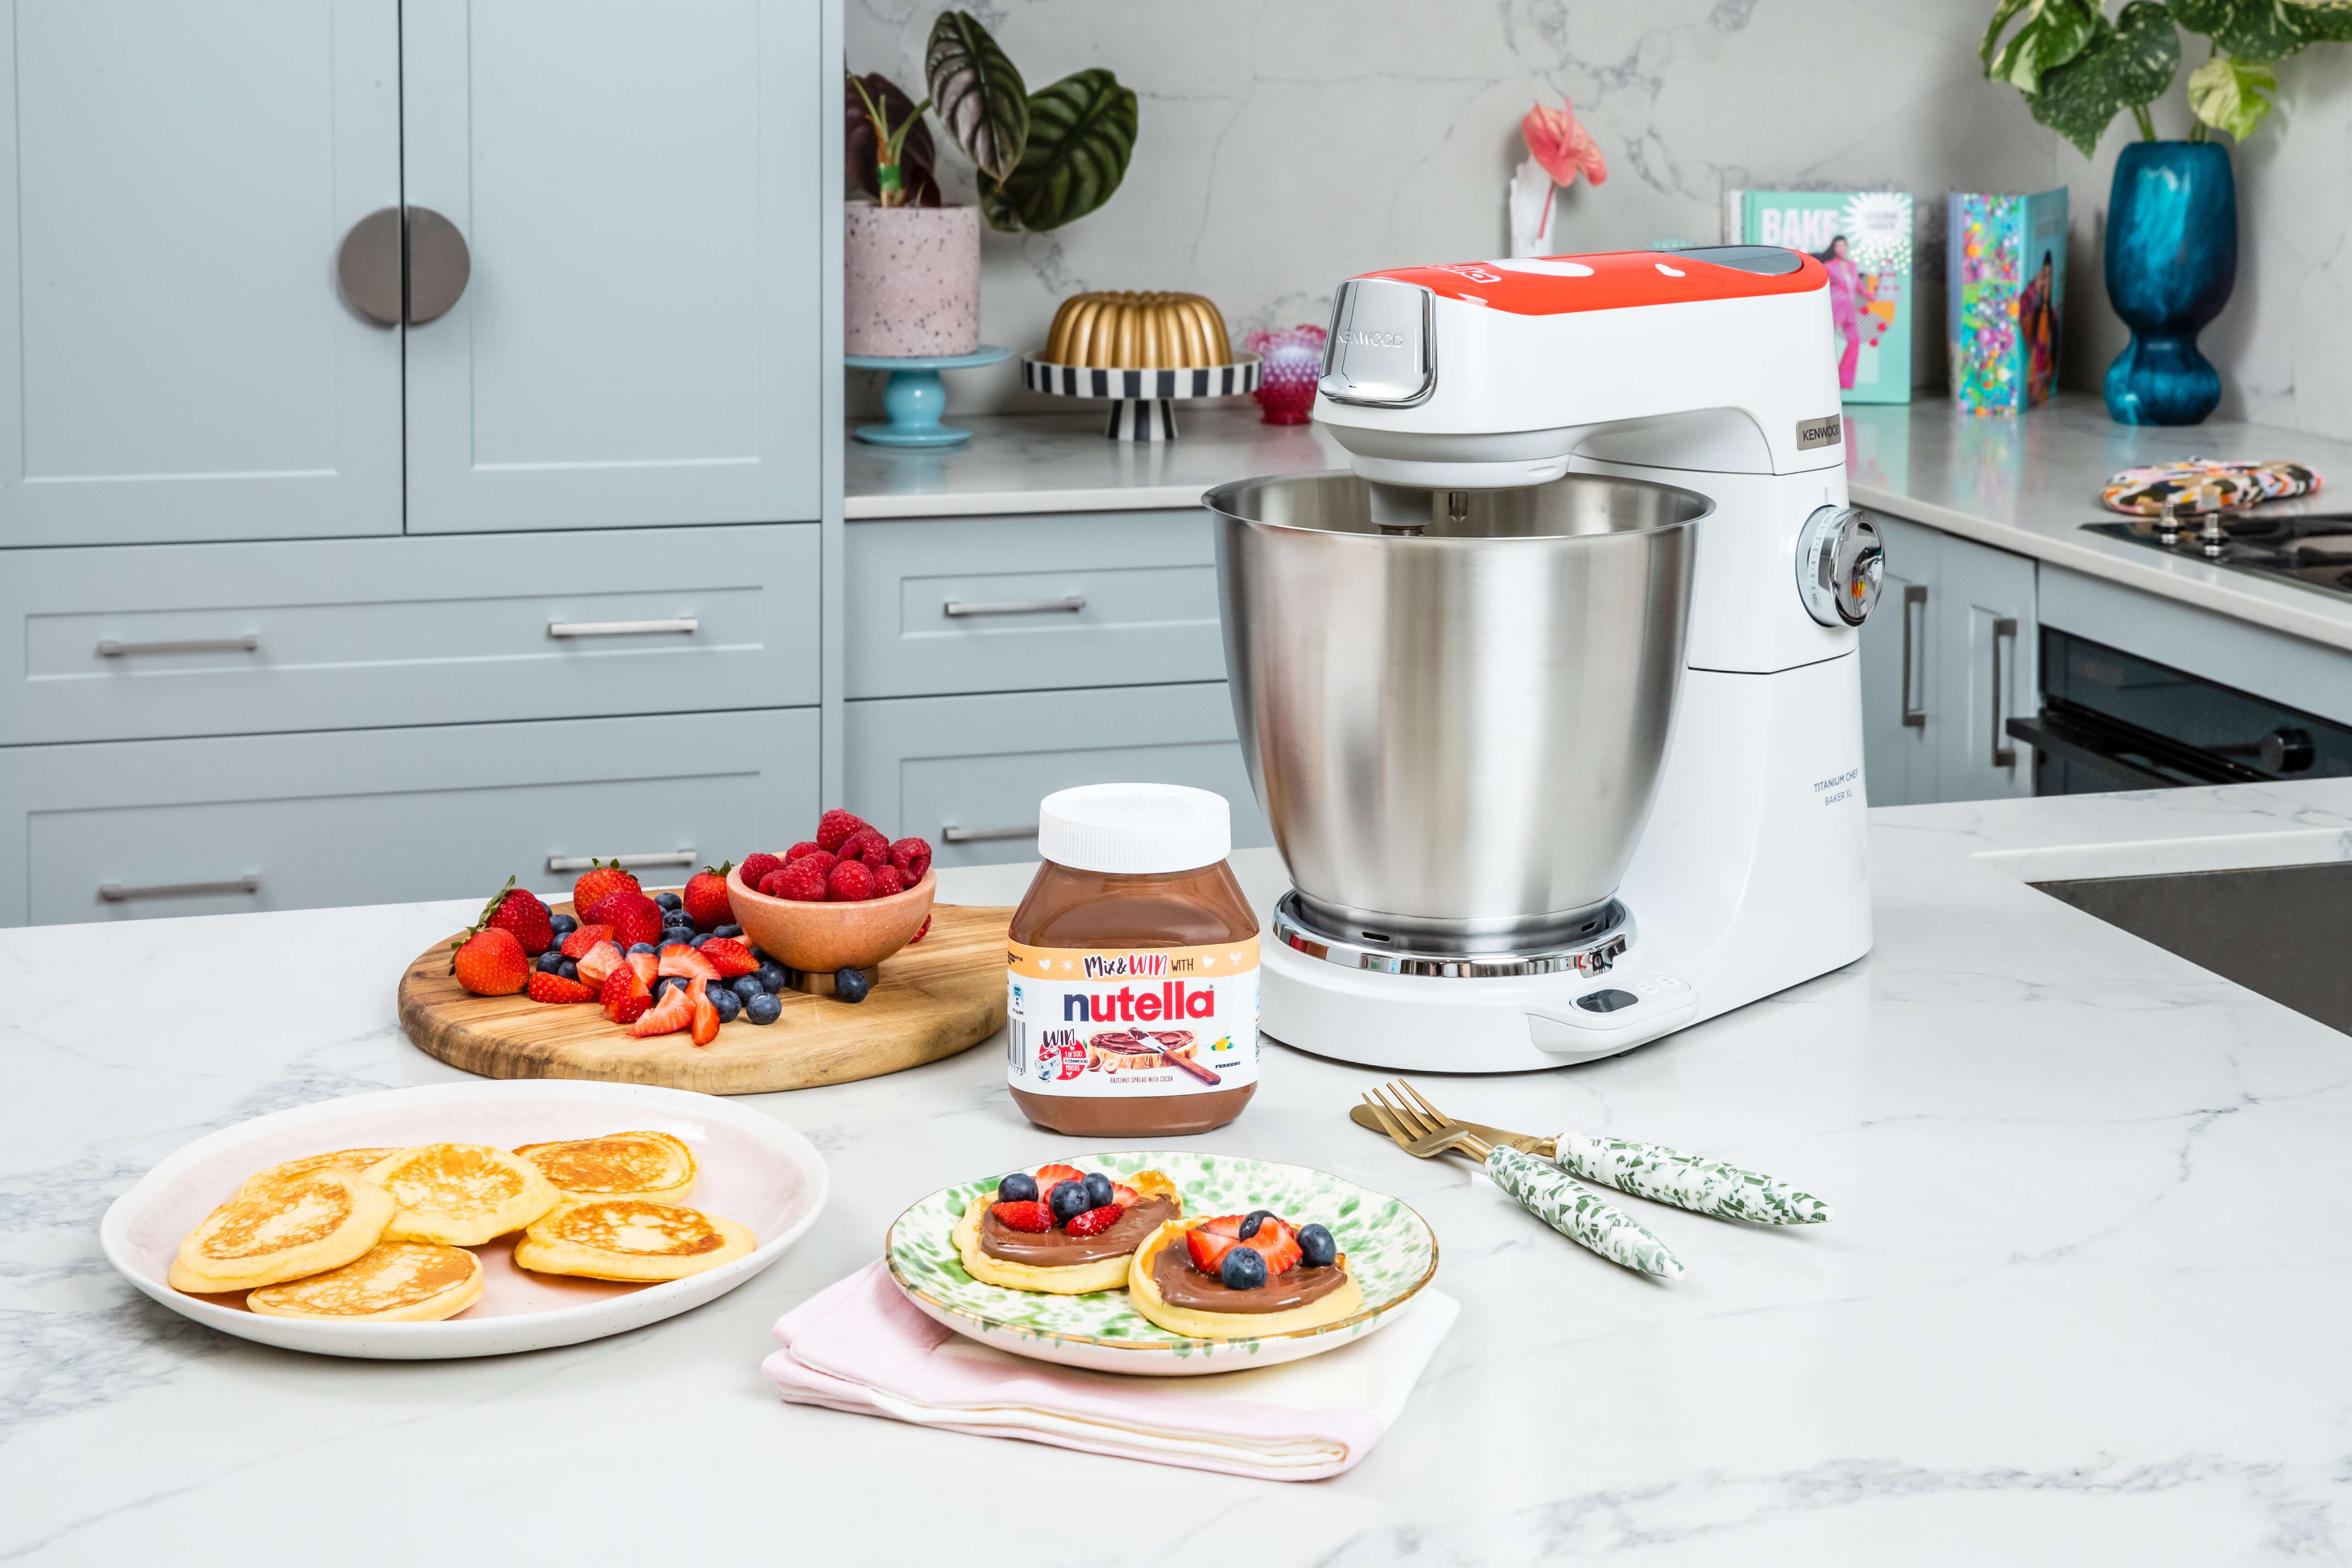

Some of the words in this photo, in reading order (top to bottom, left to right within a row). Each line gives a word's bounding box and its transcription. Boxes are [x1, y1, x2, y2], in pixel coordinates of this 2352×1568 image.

[1803, 424, 1840, 441] KENWOOD
[1814, 774, 1844, 792] TITANIUM
[1846, 768, 1858, 781] CHEF
[1825, 792, 1845, 806] BAKER
[1846, 789, 1852, 798] XL
[1171, 958, 1193, 972] WITH
[1064, 981, 1214, 1022] nutella
[1043, 1029, 1074, 1048] WIN
